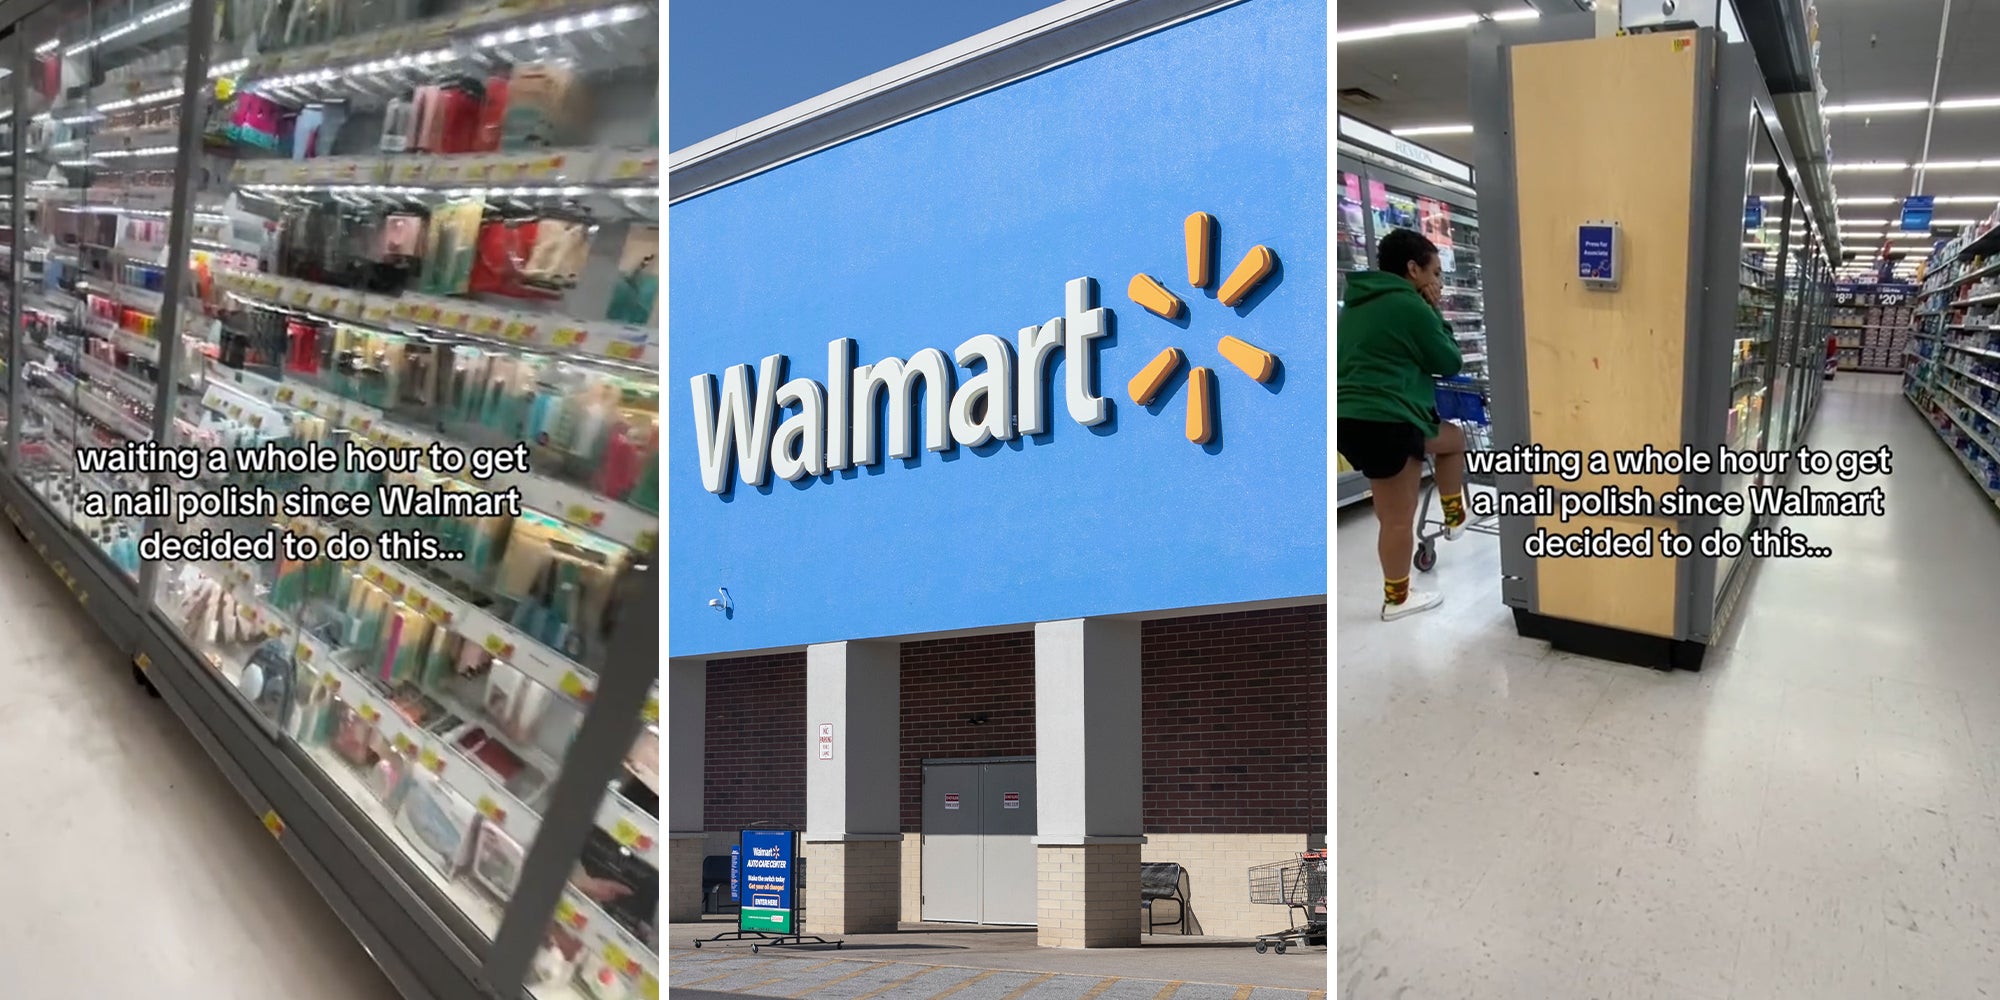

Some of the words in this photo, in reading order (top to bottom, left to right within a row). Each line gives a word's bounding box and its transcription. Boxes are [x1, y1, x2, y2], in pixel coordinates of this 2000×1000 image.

[690, 276, 1110, 494] Walmart
[753, 847, 773, 857] Walmart
[747, 859, 759, 868] AUTO
[759, 860, 770, 868] CARE
[770, 860, 787, 869] CENTER
[755, 898, 767, 906] ENTER
